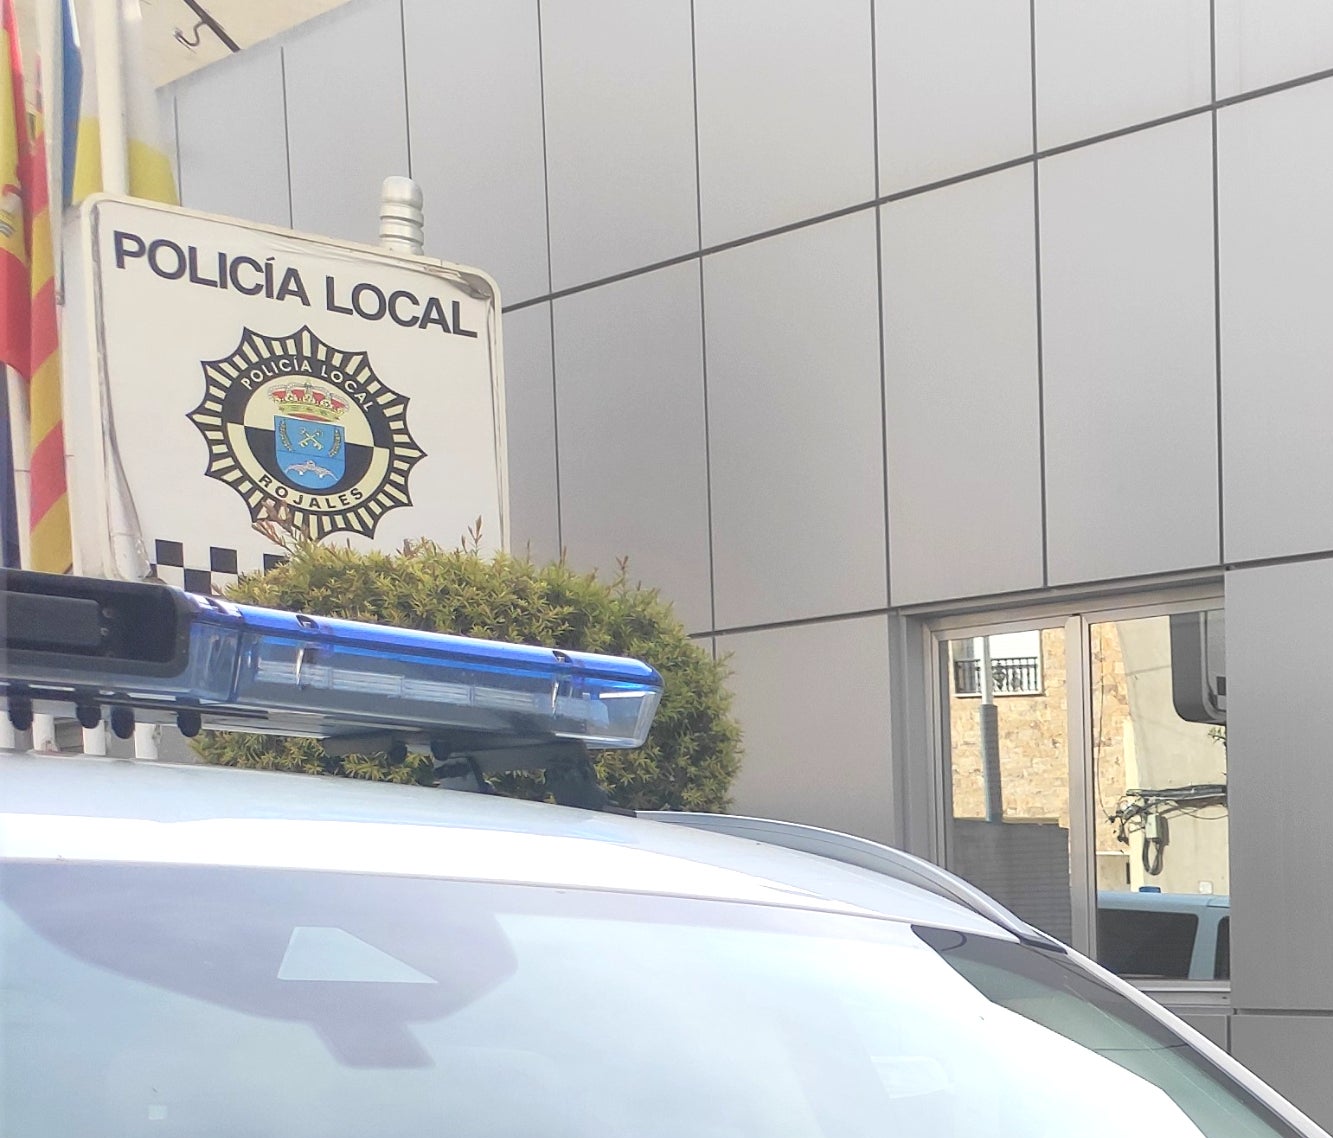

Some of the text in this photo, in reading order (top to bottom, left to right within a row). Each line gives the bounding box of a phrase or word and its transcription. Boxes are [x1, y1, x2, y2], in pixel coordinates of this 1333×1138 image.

[113, 230, 479, 338] POLICÍA LOCAL
[240, 356, 373, 412] POLICÍA LOCAL
[257, 473, 364, 510] ROJALES
